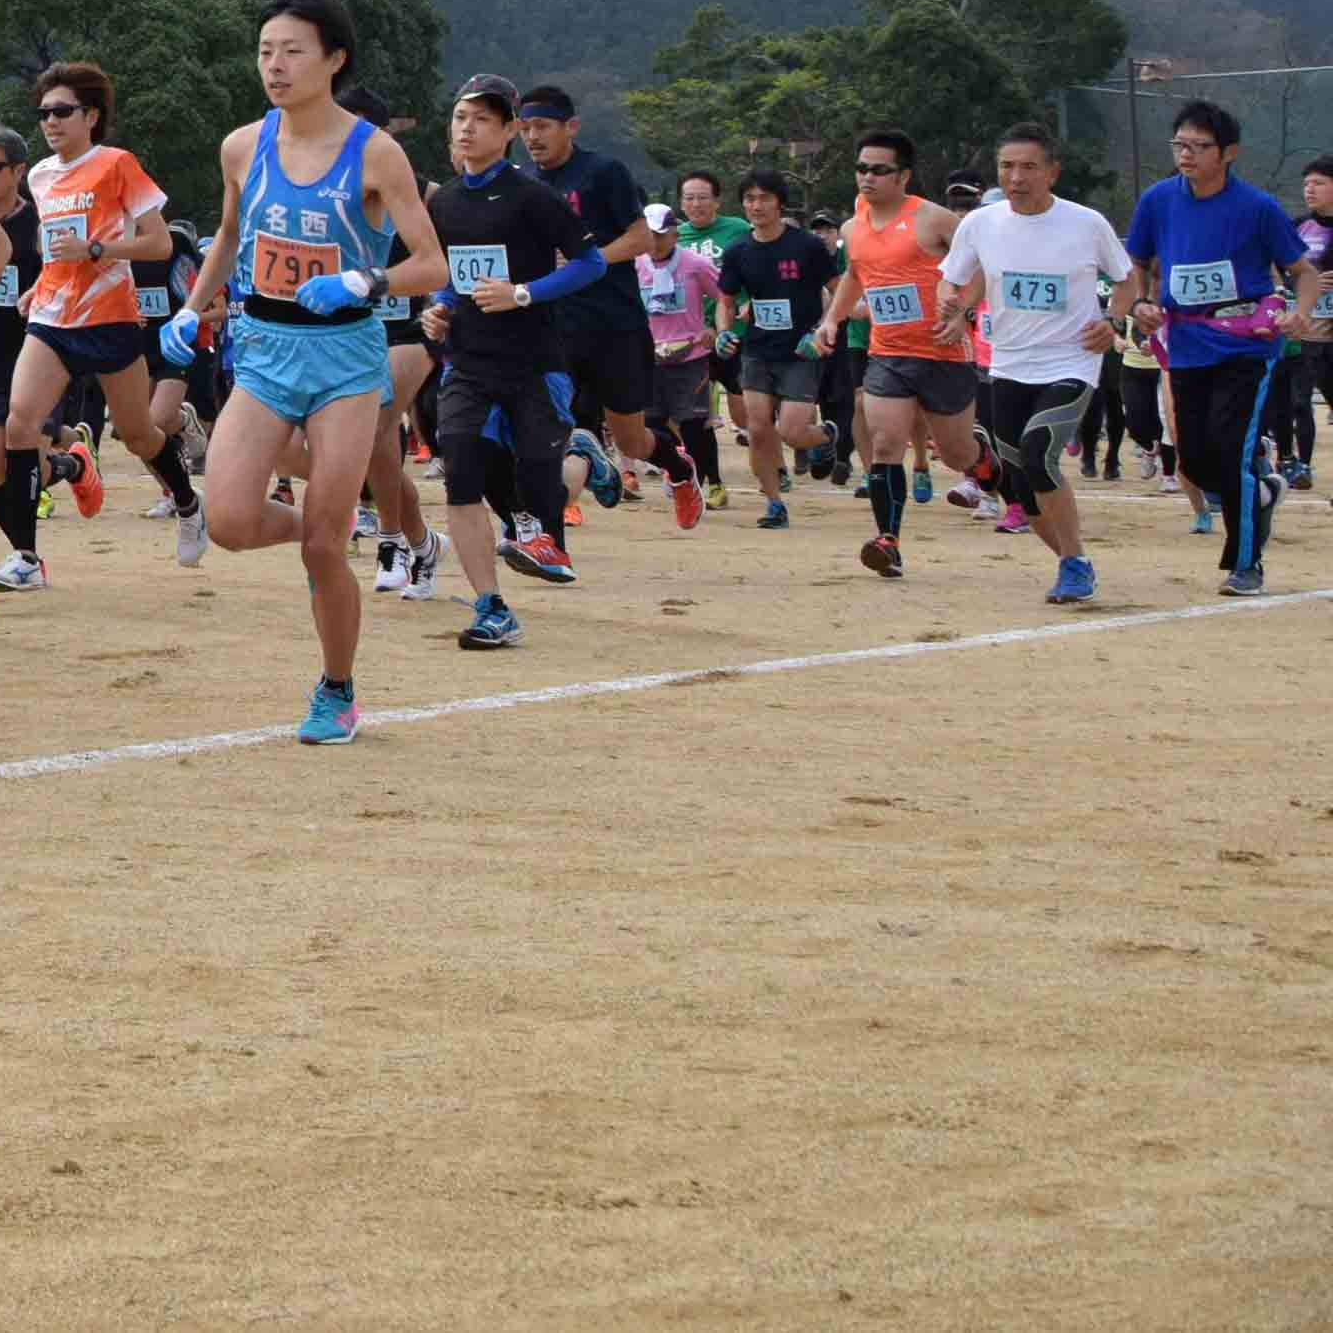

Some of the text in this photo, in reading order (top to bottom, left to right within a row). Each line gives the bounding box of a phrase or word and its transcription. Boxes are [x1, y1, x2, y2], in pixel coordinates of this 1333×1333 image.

[264, 203, 329, 238] 名西
[457, 258, 495, 281] 607
[1010, 279, 1057, 303] 479
[1179, 272, 1223, 295] 759
[874, 294, 910, 314] 490
